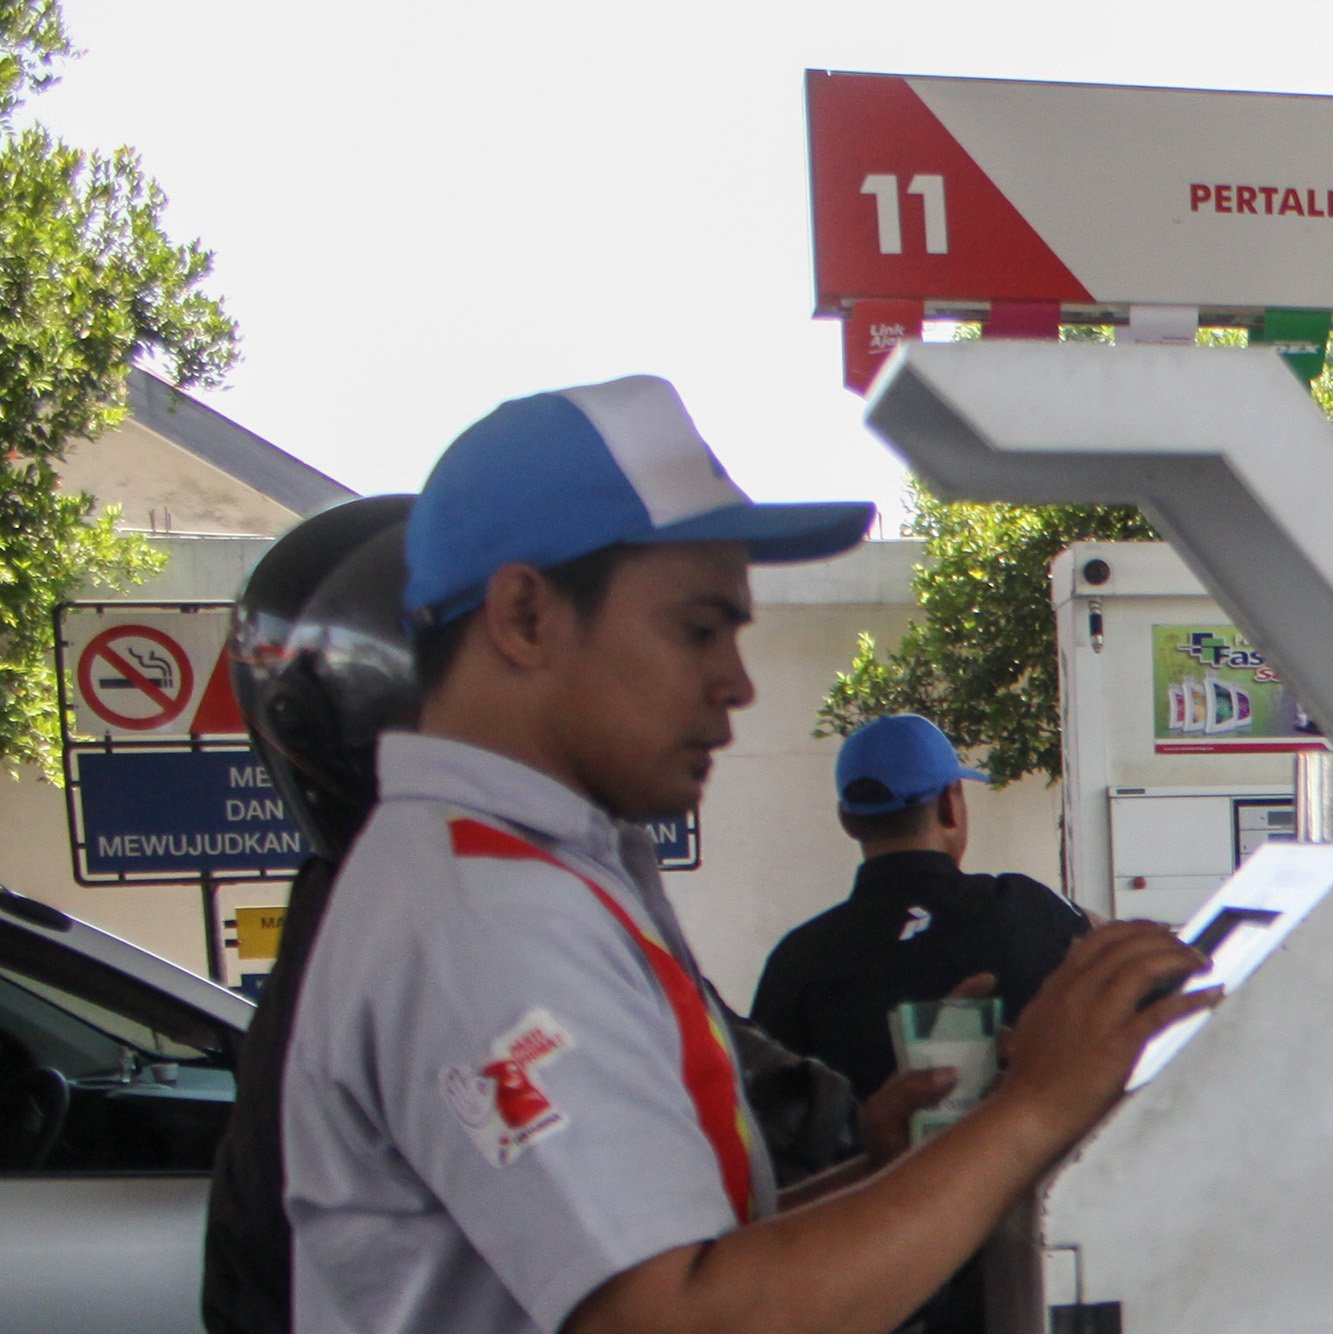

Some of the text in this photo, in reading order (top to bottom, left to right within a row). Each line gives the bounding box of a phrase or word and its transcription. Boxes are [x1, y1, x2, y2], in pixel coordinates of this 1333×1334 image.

[859, 174, 949, 255] 11
[1213, 646, 1265, 667] Fas
[225, 799, 284, 822] DAN
[98, 832, 301, 858] MEWUJUDKAN
